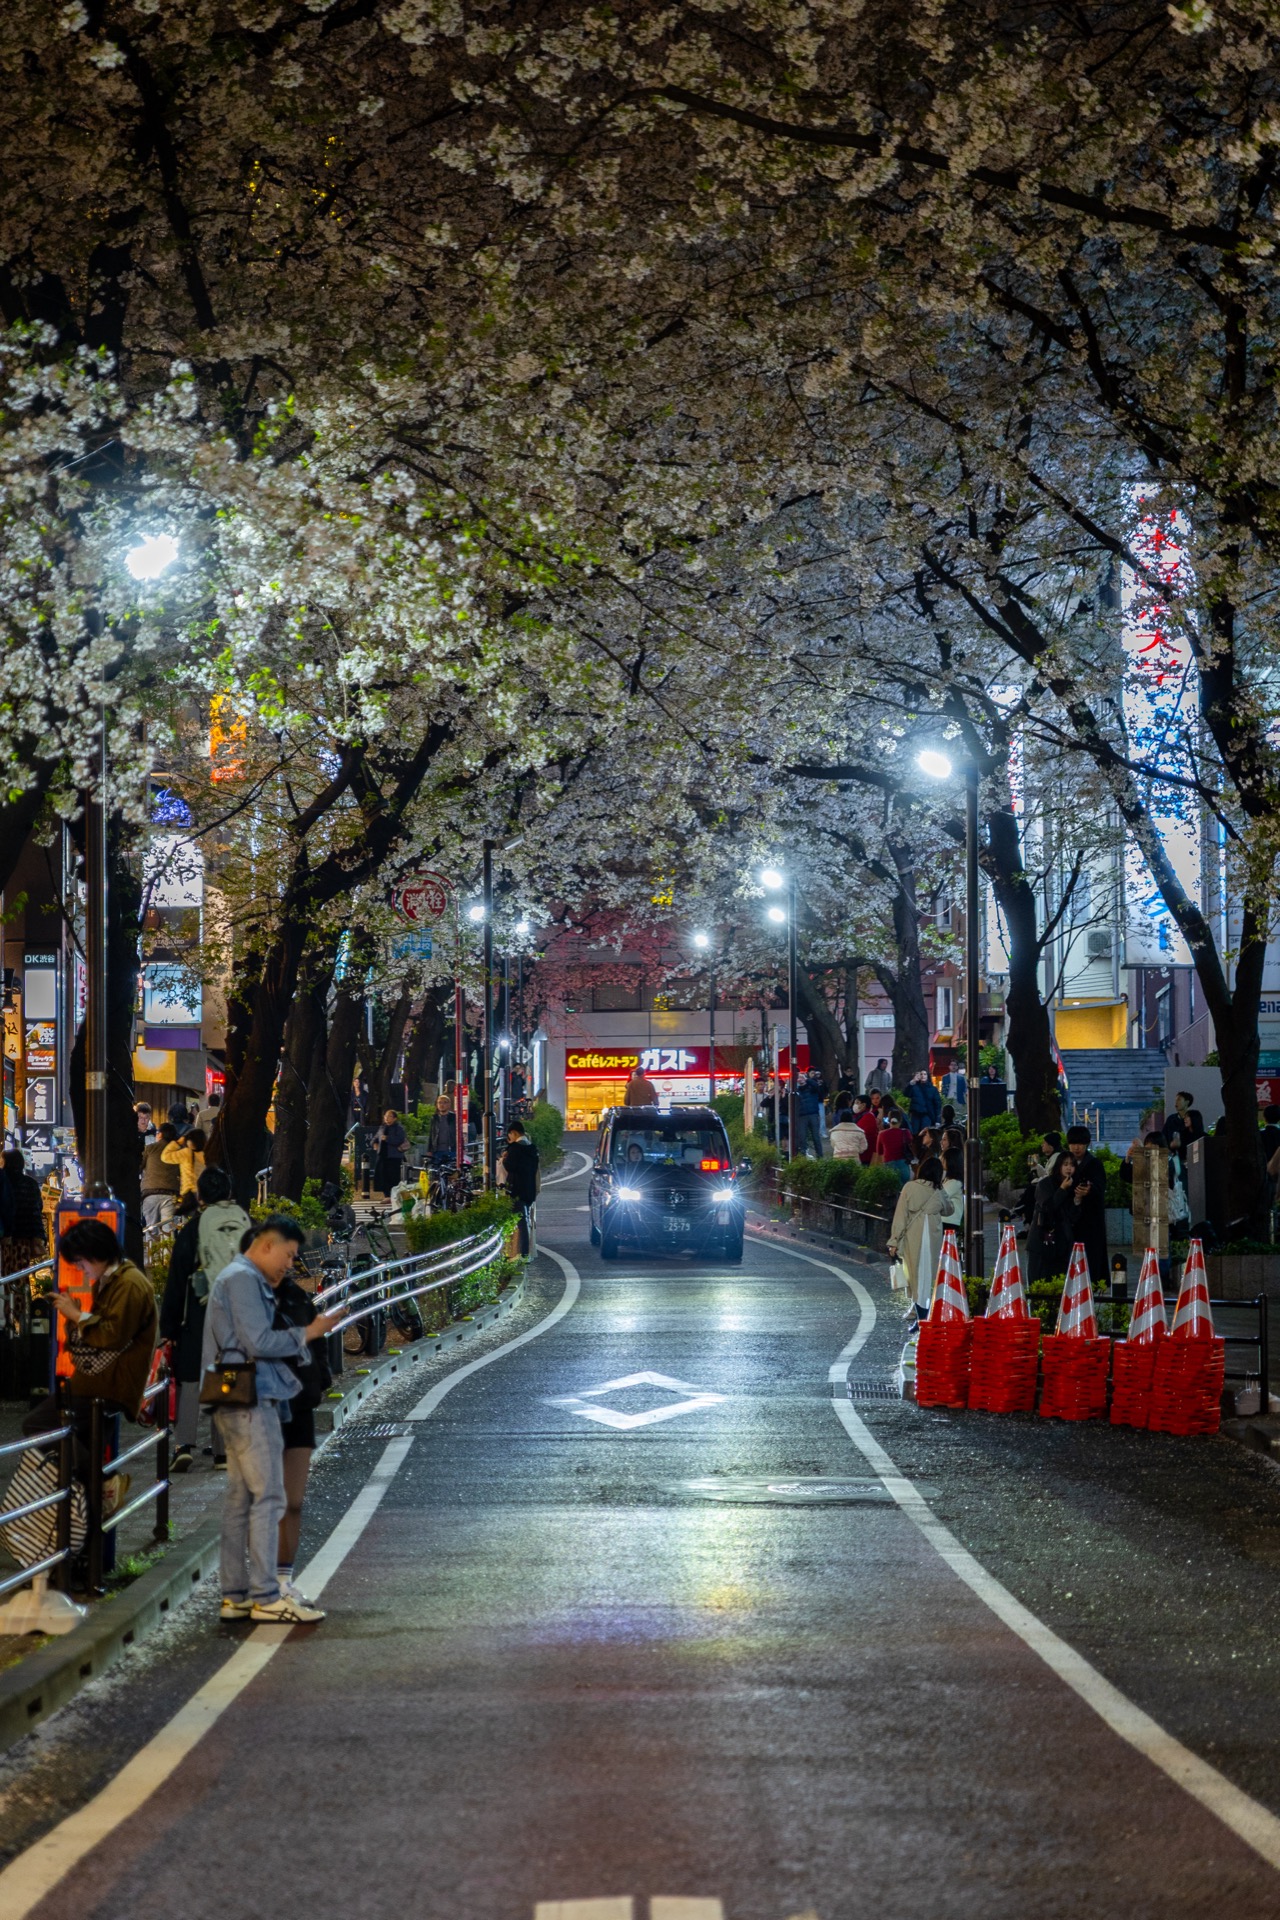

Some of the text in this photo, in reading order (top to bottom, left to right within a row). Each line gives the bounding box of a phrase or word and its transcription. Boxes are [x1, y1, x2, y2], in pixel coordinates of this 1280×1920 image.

[25, 954, 55, 963] DK渋谷
[640, 1047, 697, 1071] ガスト
